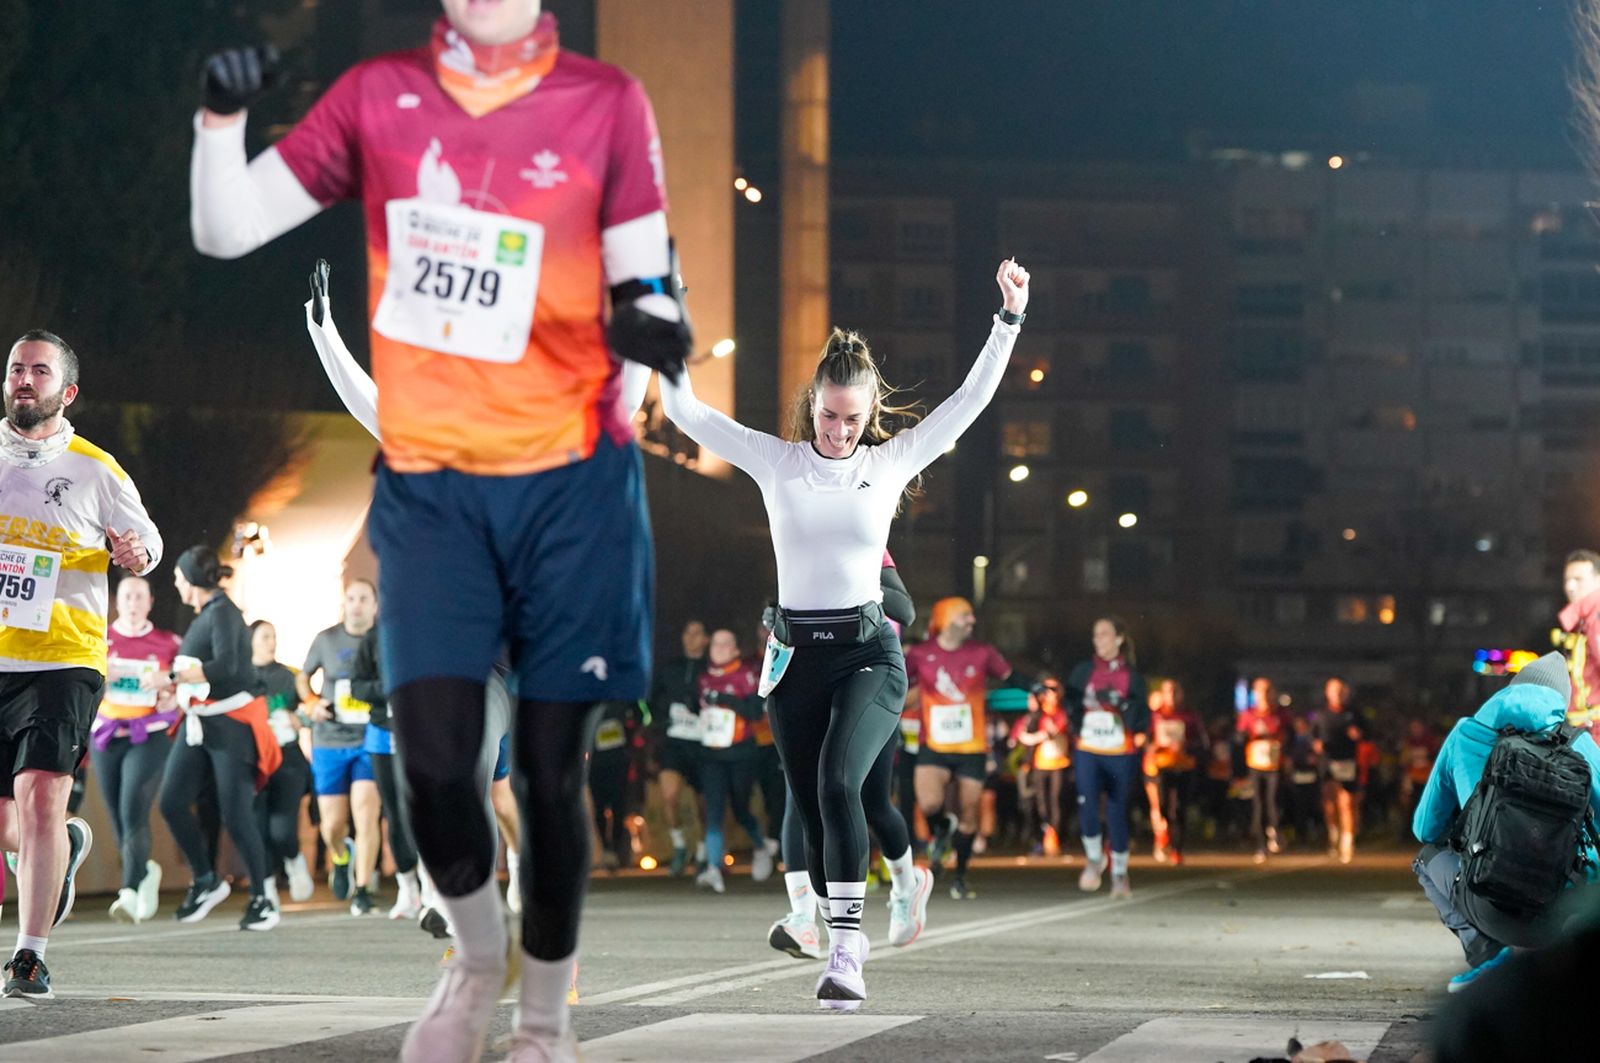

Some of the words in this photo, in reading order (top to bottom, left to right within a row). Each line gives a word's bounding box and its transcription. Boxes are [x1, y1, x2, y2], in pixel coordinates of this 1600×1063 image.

[414, 256, 500, 307] 2579
[16, 555, 26, 565] DE
[812, 631, 834, 640] FILA
